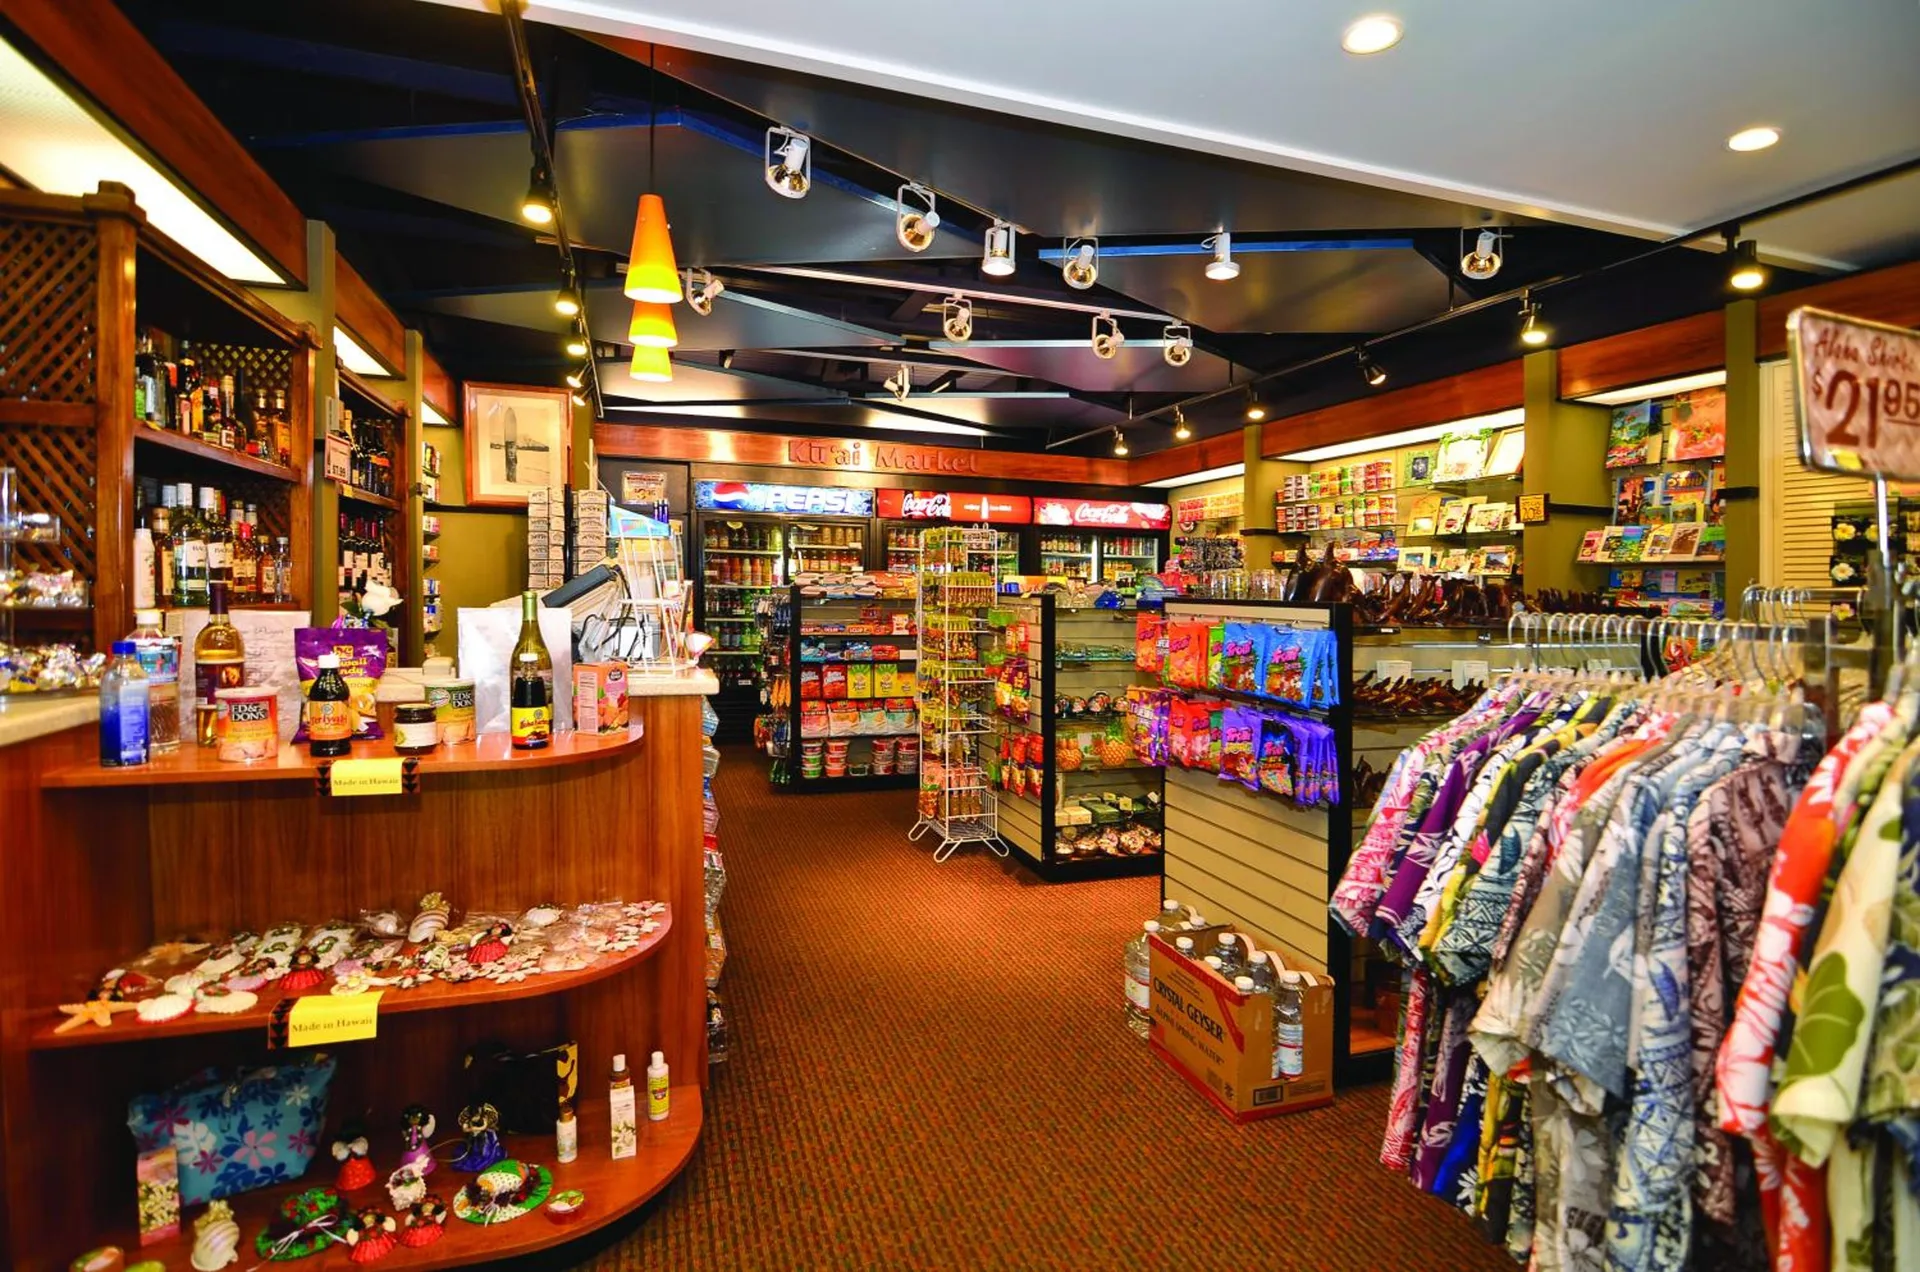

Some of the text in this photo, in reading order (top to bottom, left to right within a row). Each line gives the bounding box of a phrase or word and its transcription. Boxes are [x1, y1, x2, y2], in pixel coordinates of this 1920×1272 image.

[875, 446, 978, 474] Market
[764, 484, 854, 517] PEPSI
[1074, 503, 1131, 524] Coca-Cola
[334, 778, 356, 786] Made
[1153, 976, 1184, 1014] CRYSTAL
[1186, 1003, 1224, 1044] GEYSER
[292, 1016, 373, 1033] Made in Hawaii
